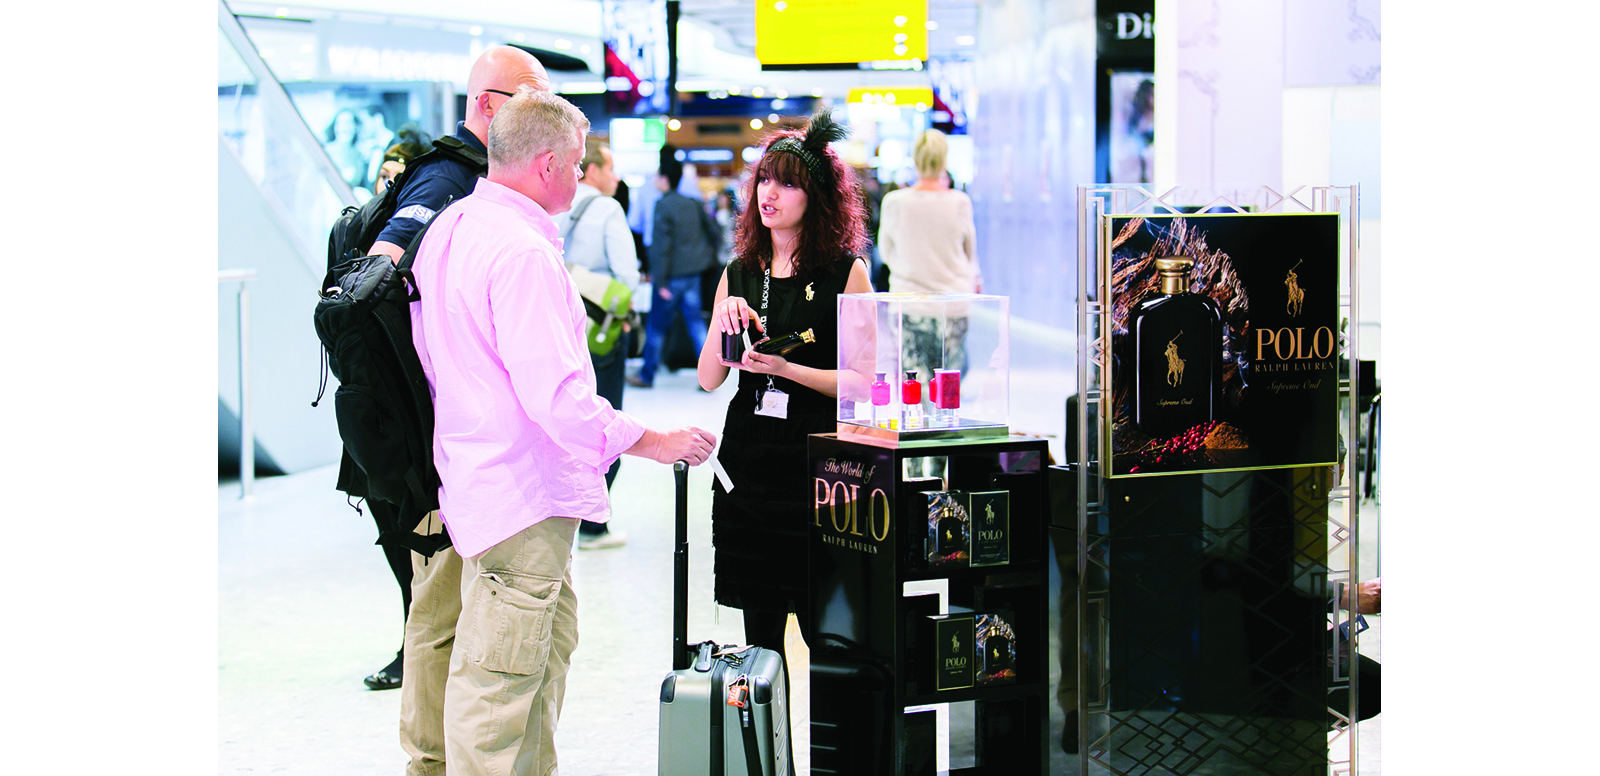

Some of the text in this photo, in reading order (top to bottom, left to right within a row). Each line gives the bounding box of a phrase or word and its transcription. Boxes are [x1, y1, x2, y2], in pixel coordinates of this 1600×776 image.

[1116, 11, 1155, 39] Di
[761, 275, 770, 309] BLACKJACK
[1255, 326, 1334, 360] POLO
[1255, 361, 1334, 372] RALPH LAUREN
[1268, 379, 1321, 394] Supreme Oud
[1157, 398, 1180, 407] Supreme
[824, 457, 877, 484] The World of
[812, 476, 890, 541] POLO
[822, 533, 878, 555] RALPH LAUREN
[978, 529, 1003, 541] POLO
[945, 656, 967, 668] POLO
